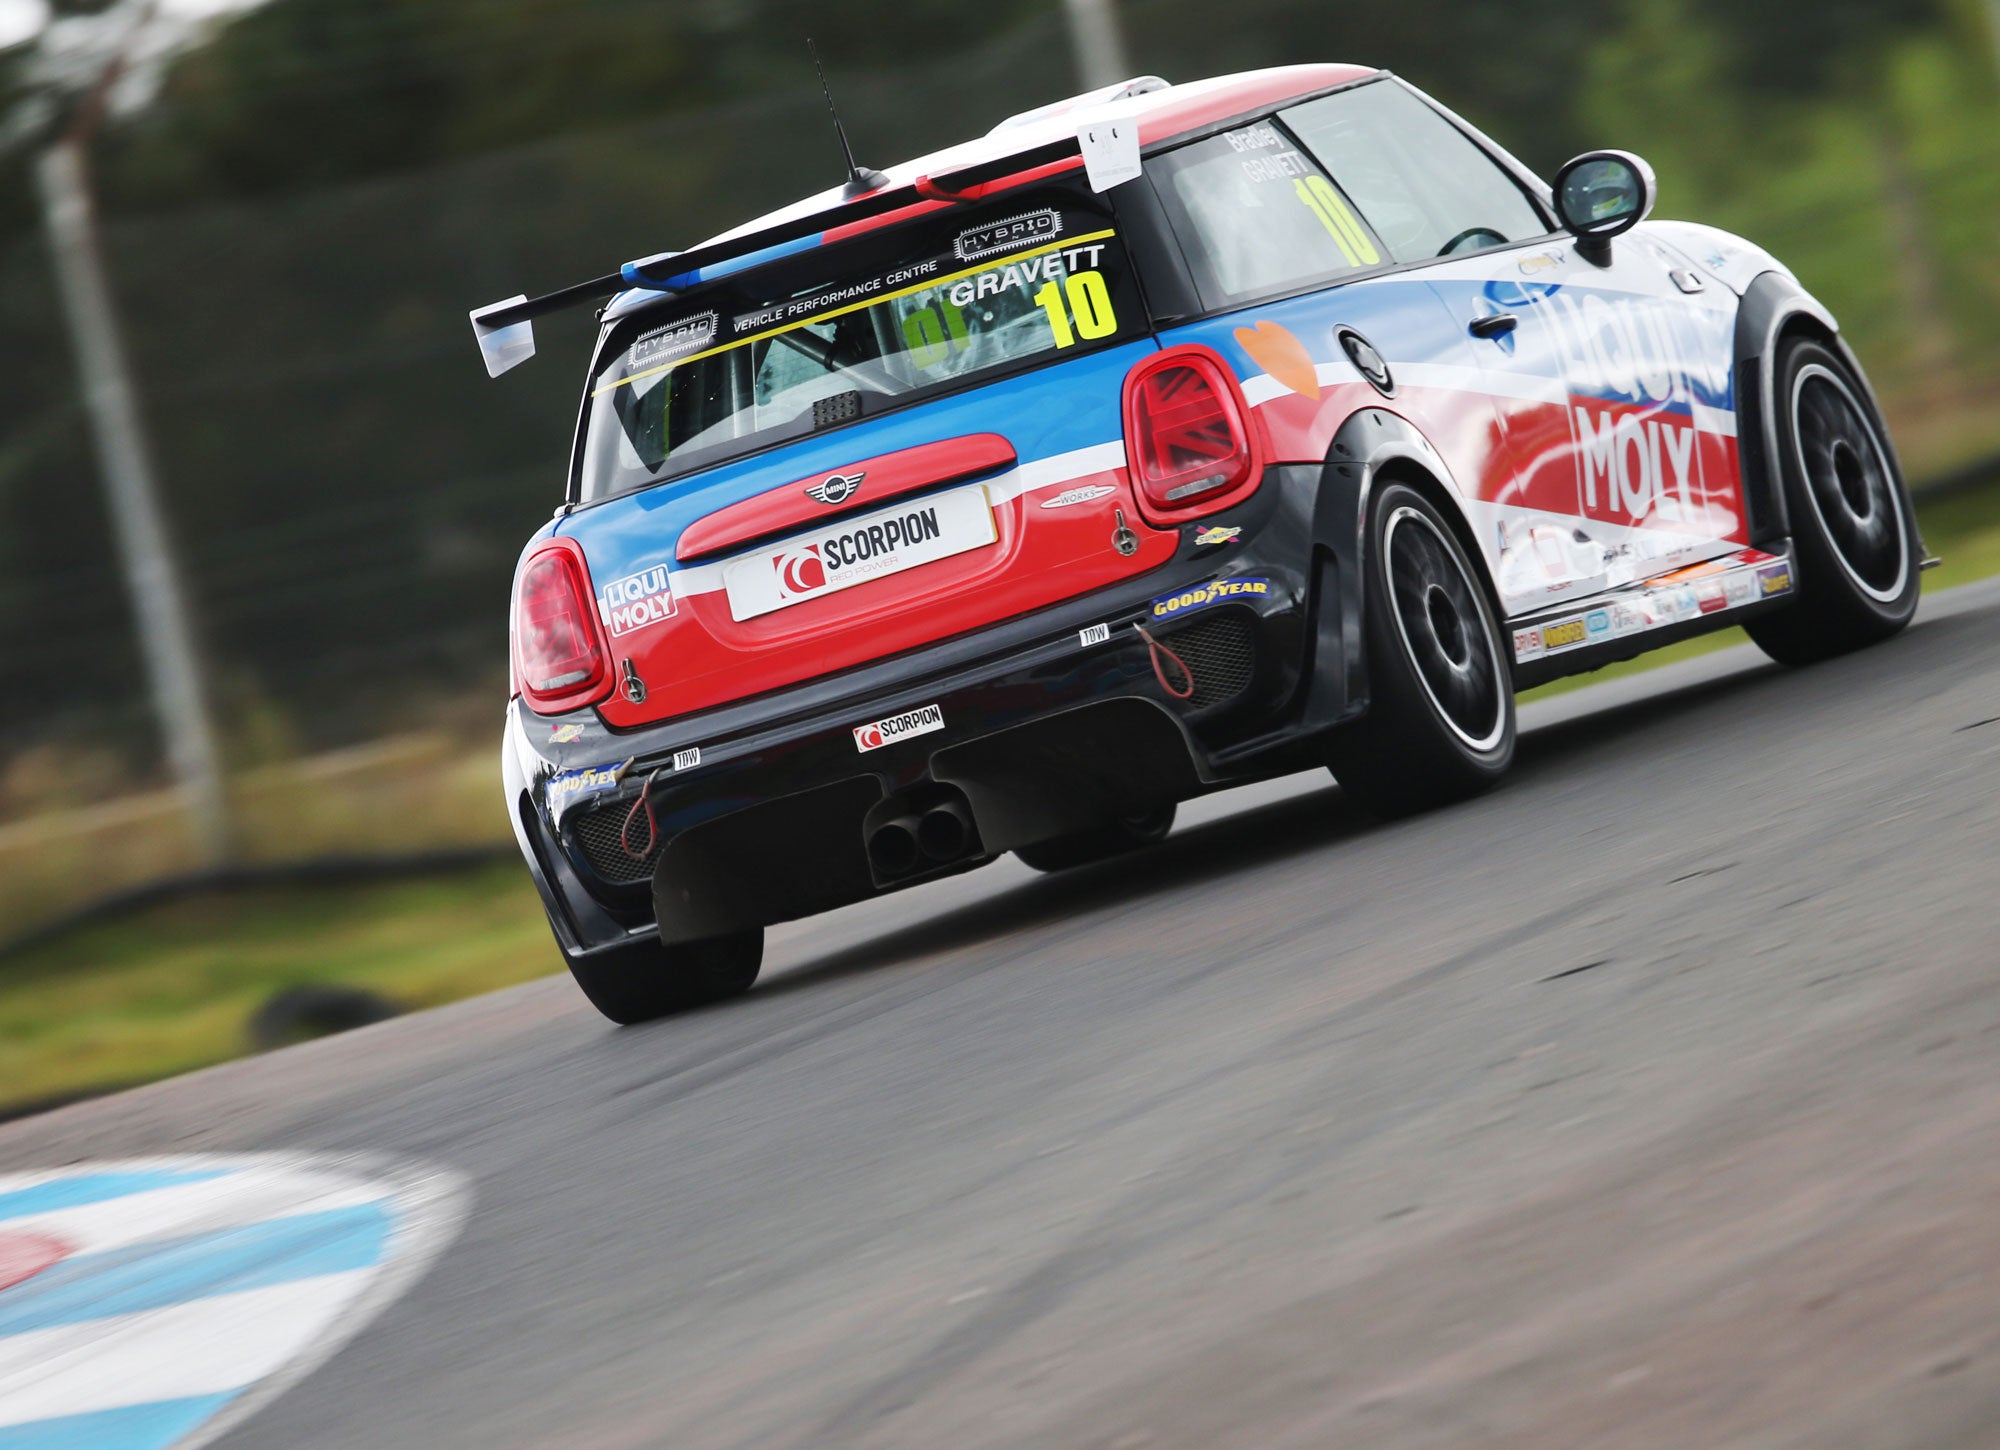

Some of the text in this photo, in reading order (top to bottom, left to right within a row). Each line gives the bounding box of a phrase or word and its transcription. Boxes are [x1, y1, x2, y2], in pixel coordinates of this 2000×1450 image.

[1223, 125, 1284, 152] Bradley
[1241, 150, 1308, 183] GRAVETT
[963, 216, 1051, 248] HYBRID
[1292, 175, 1380, 267] 10
[950, 244, 1105, 307] GRAVETT
[733, 260, 938, 333] VEHICLE PERFORMANCE CENTRE
[1033, 270, 1117, 350] 10
[637, 320, 709, 354] HYBRID
[1575, 407, 1697, 525] MOLY
[825, 482, 846, 495] MINI
[1060, 489, 1096, 504] WORKS
[824, 507, 940, 570] SCORPION
[830, 556, 898, 584] RED POWER
[607, 568, 667, 609] LIQUI
[1153, 580, 1268, 616] GOODYEAR
[612, 591, 671, 633] MOLY
[1083, 625, 1105, 644] TOW
[880, 706, 941, 737] SCORPION
[676, 749, 699, 769] TOW
